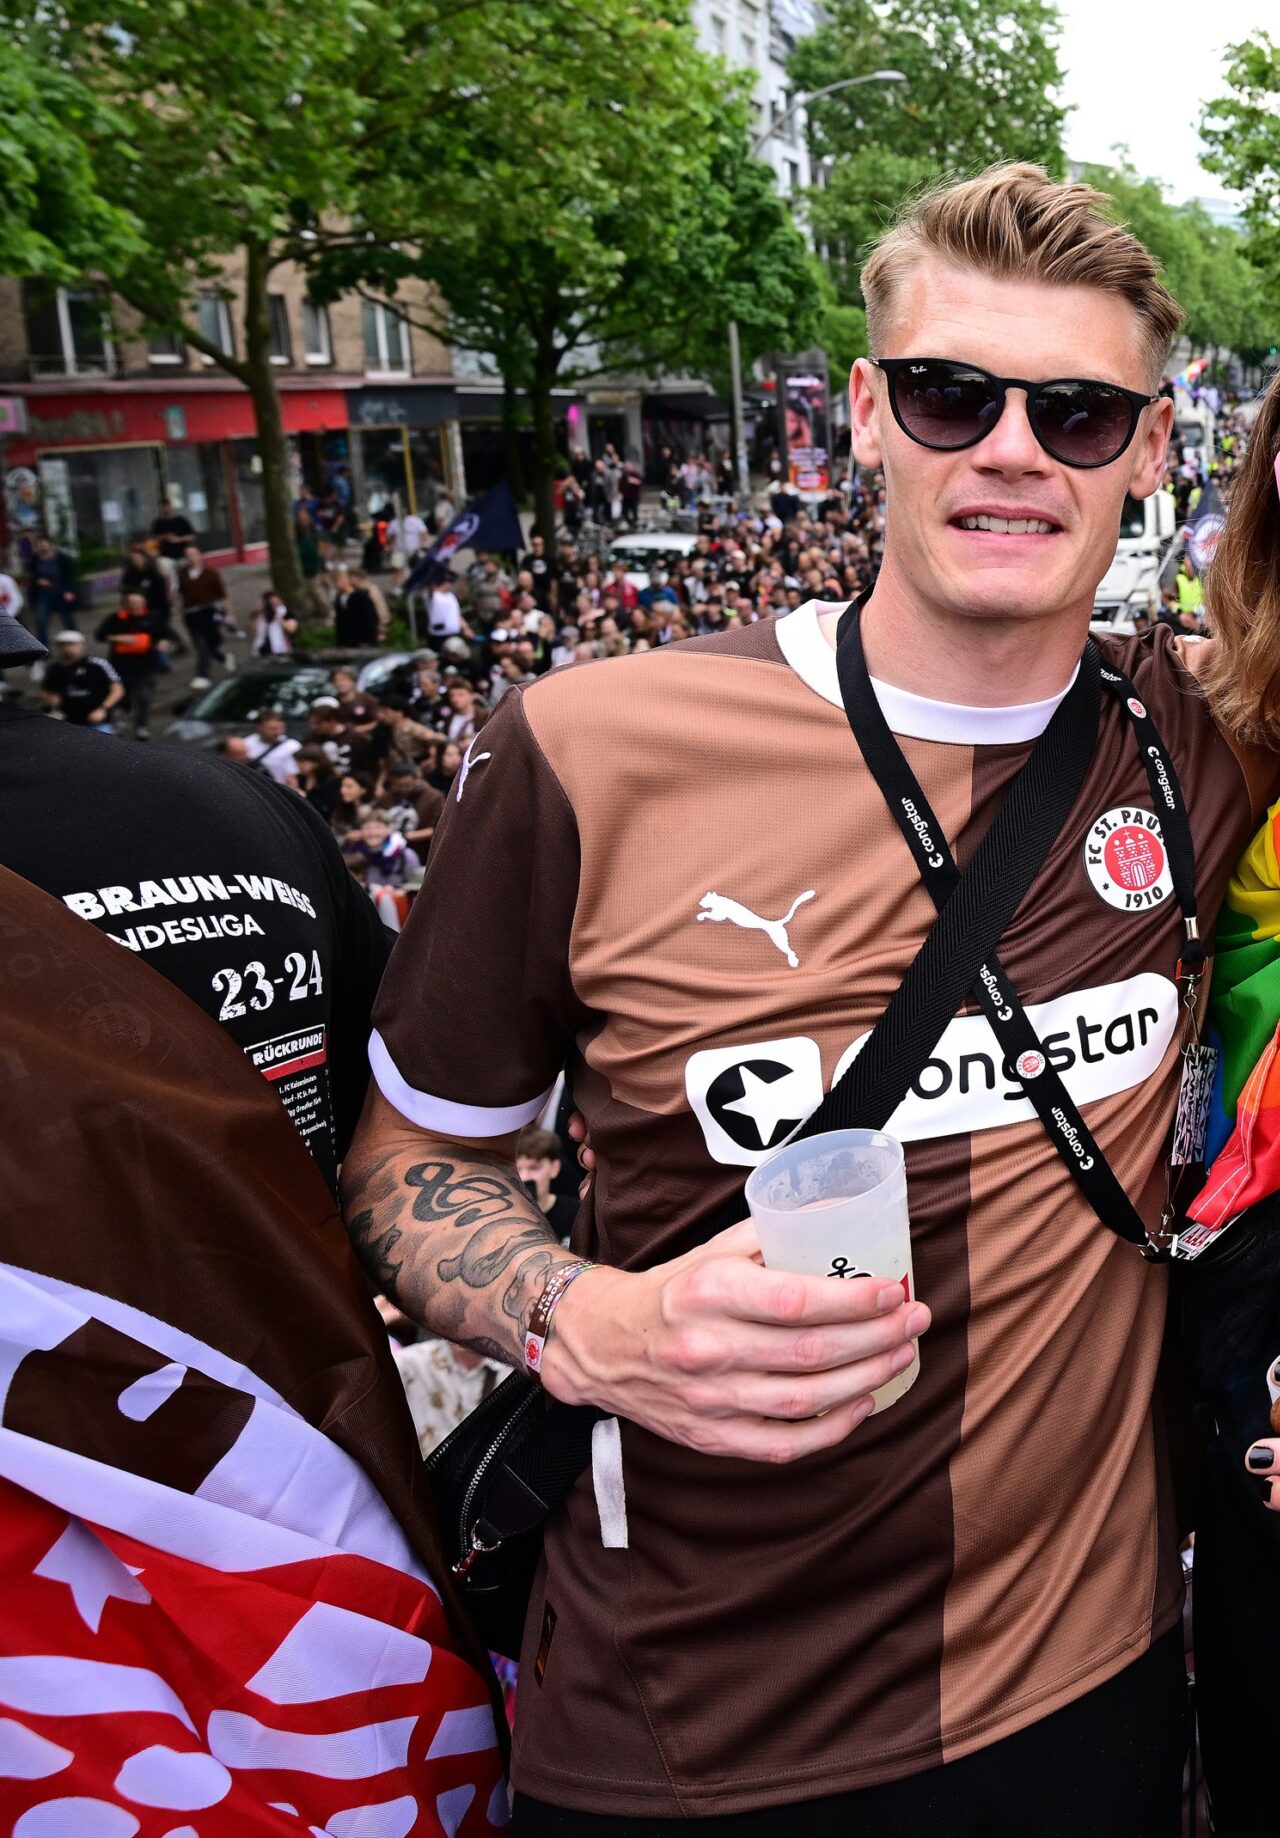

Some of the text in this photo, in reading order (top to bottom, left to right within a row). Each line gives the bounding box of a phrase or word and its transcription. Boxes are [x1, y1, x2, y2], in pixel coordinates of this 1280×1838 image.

[1154, 758, 1176, 811] congstar
[901, 796, 935, 859] congstar
[1088, 844, 1102, 865] FC
[62, 874, 317, 920] BRAUN-WEISS
[1125, 886, 1164, 908] 1910
[211, 949, 324, 1022] 23-24
[252, 1032, 323, 1066] RÜCKRUNDE
[1051, 1106, 1086, 1162] congstar
[537, 1294, 549, 1310] FC
[539, 1276, 564, 1323] SAISON
